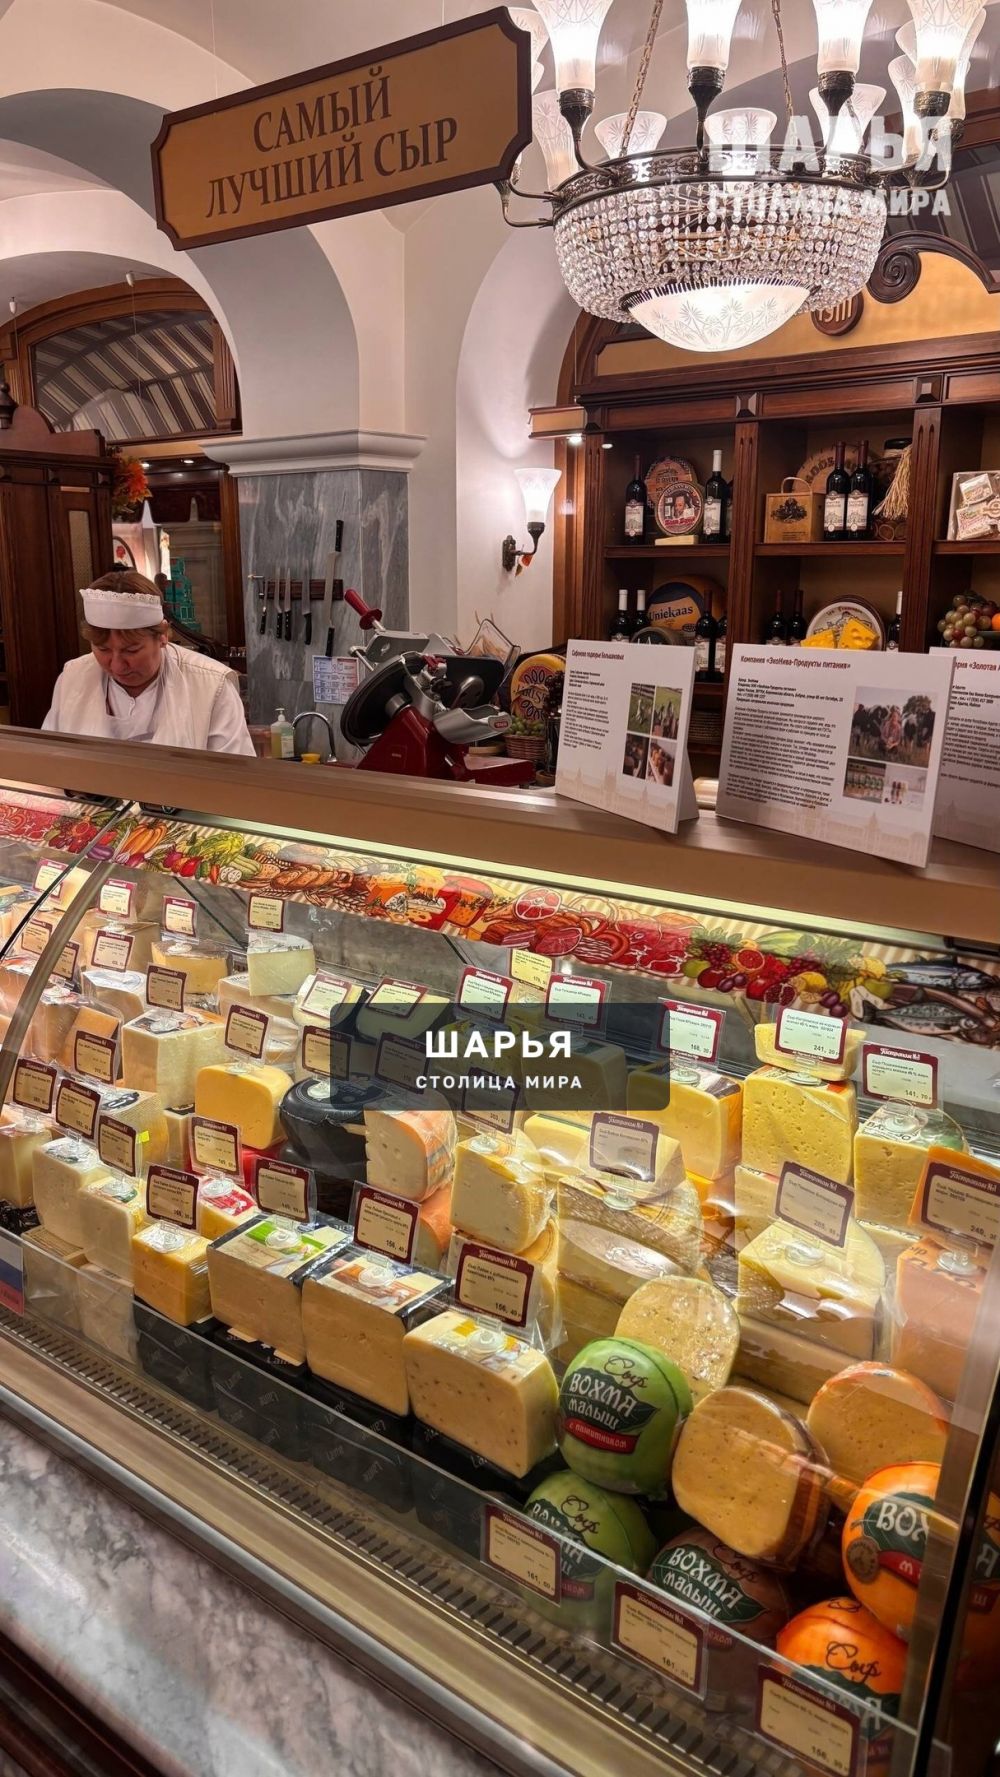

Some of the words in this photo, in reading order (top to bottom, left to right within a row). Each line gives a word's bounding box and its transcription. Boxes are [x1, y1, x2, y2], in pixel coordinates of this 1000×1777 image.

[253, 66, 391, 153] САМЫЙ
[205, 135, 364, 219] ЛУЧШИЙ
[373, 117, 458, 178] СЫР
[649, 606, 694, 621] Uniekaas
[569, 1372, 638, 1418] ВОХМА
[575, 1423, 627, 1449] пажитником
[668, 1547, 744, 1609] ВОХМА
[826, 1641, 881, 1684] Сыр
